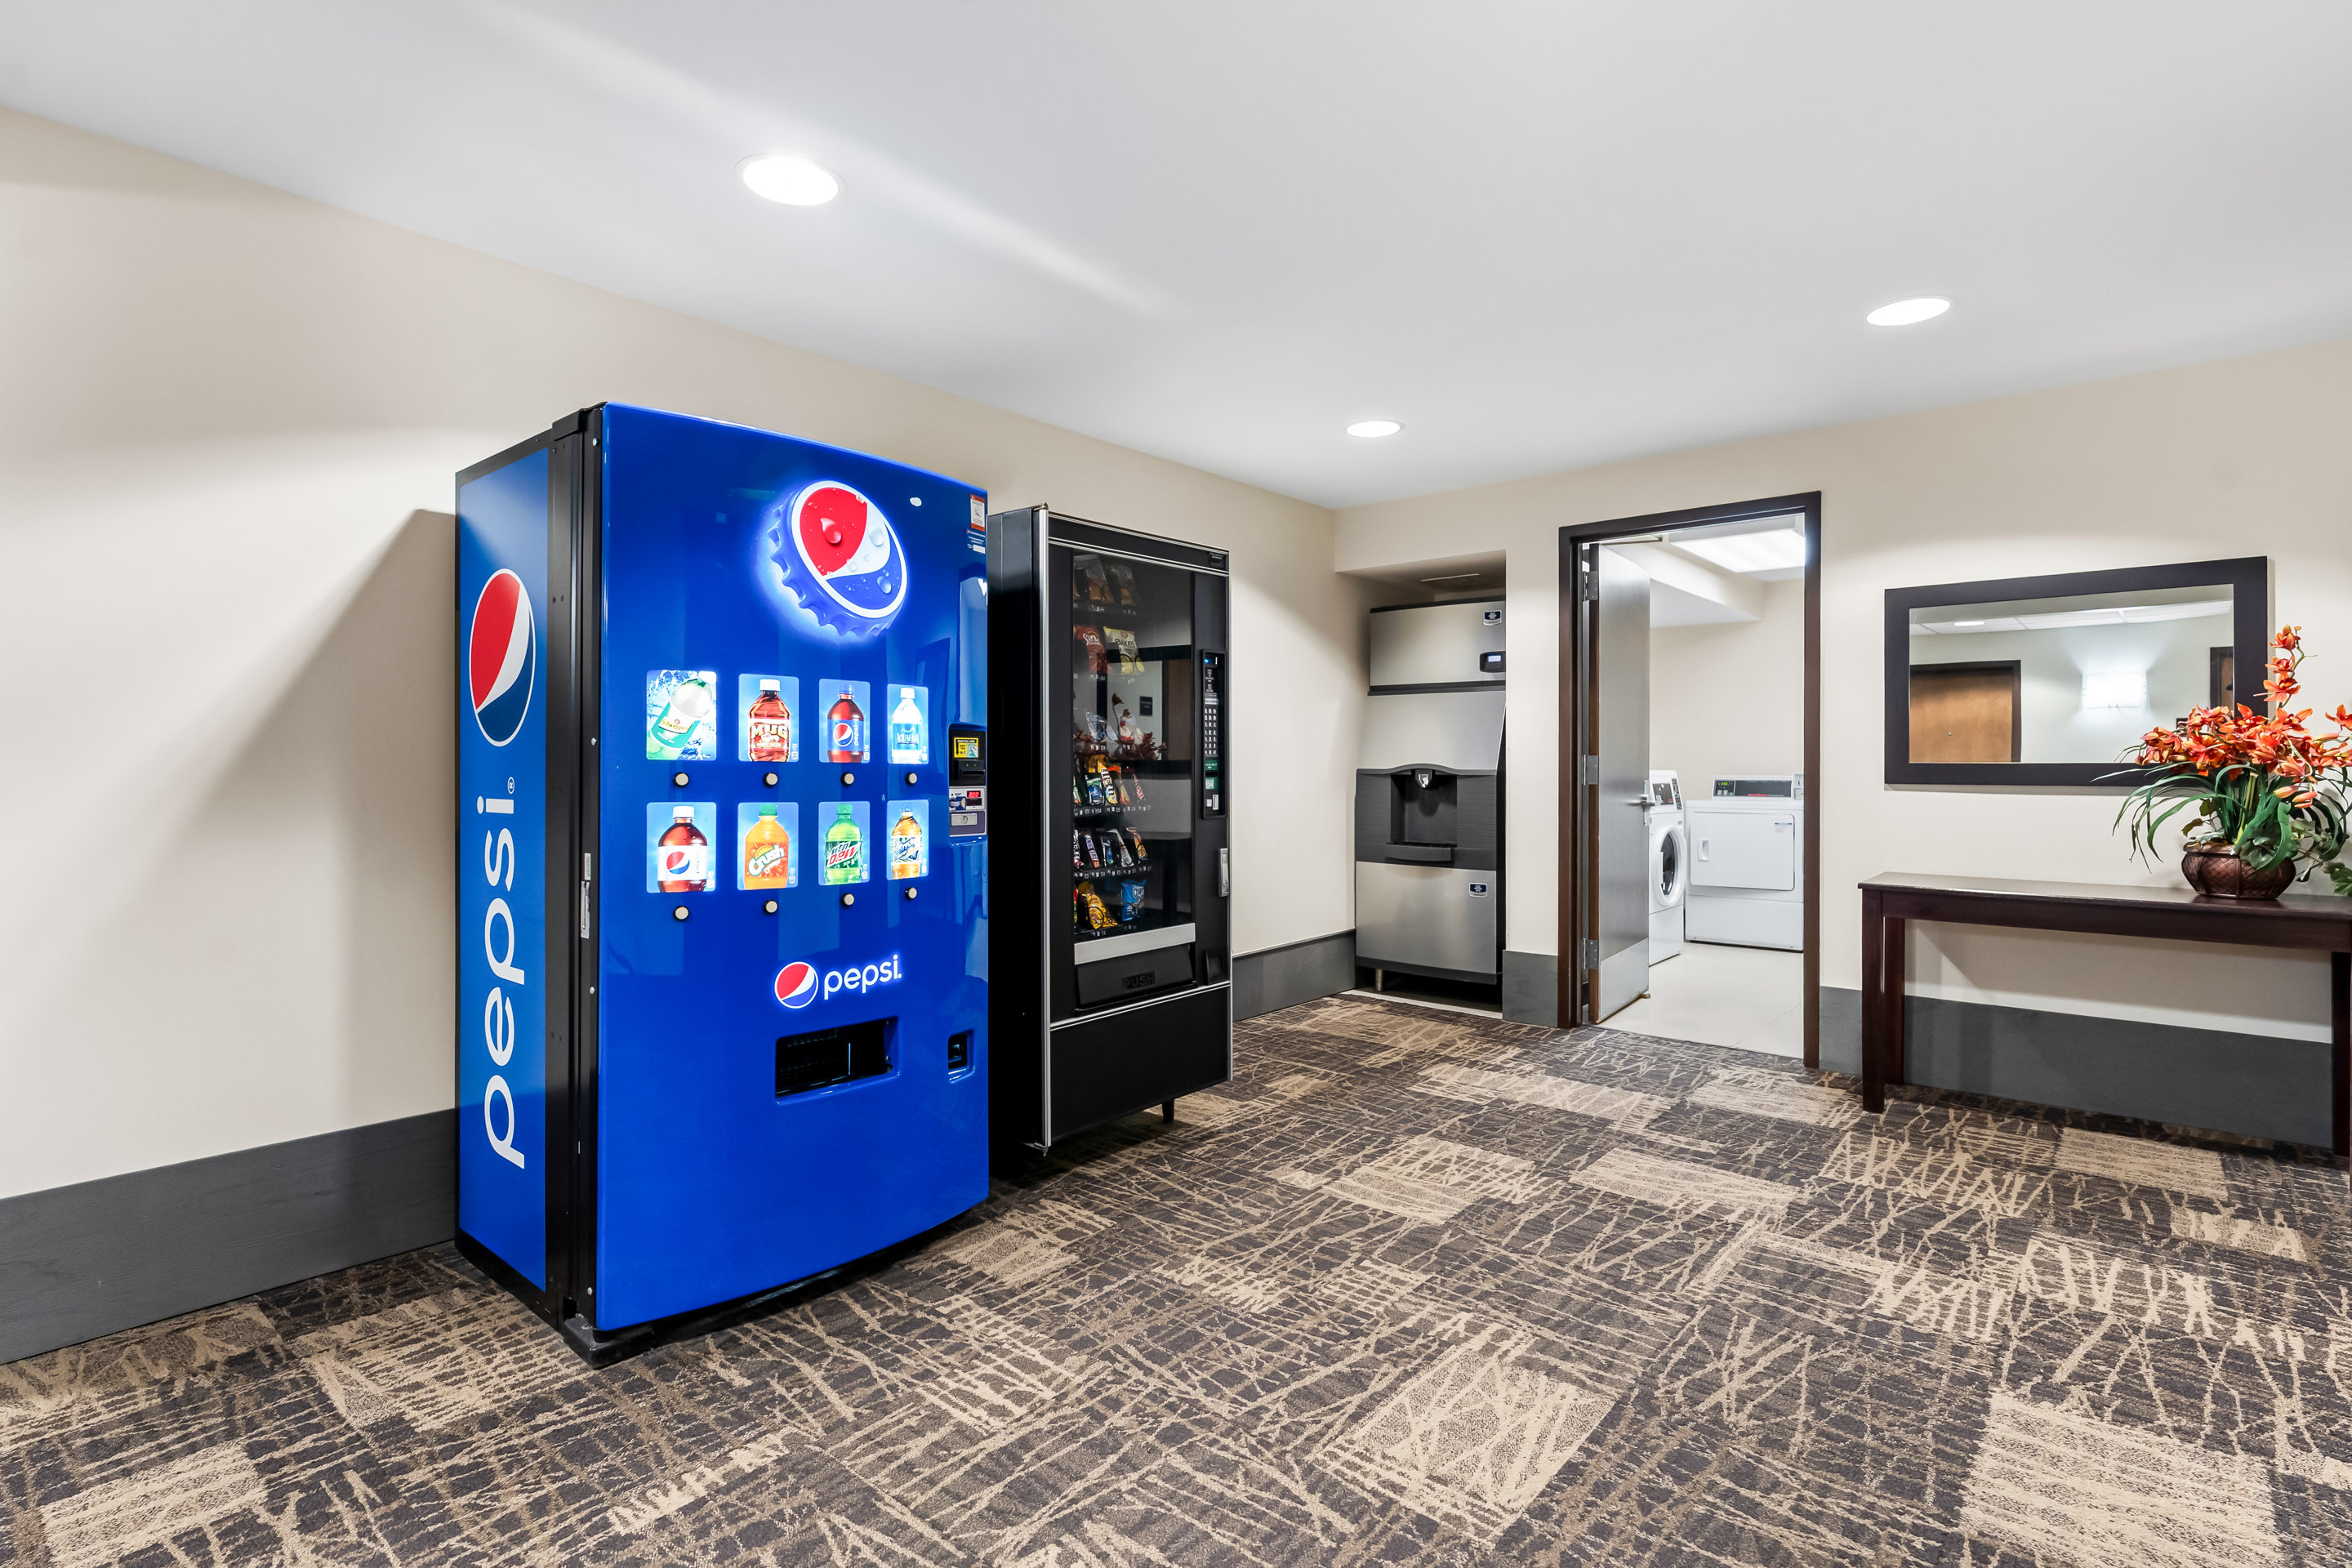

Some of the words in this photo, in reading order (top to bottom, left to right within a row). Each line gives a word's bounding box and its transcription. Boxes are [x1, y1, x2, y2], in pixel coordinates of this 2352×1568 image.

[751, 724, 788, 739] MUG
[748, 844, 785, 876] Crush
[477, 797, 525, 1169] pepsi
[1124, 973, 1155, 988] PUSH
